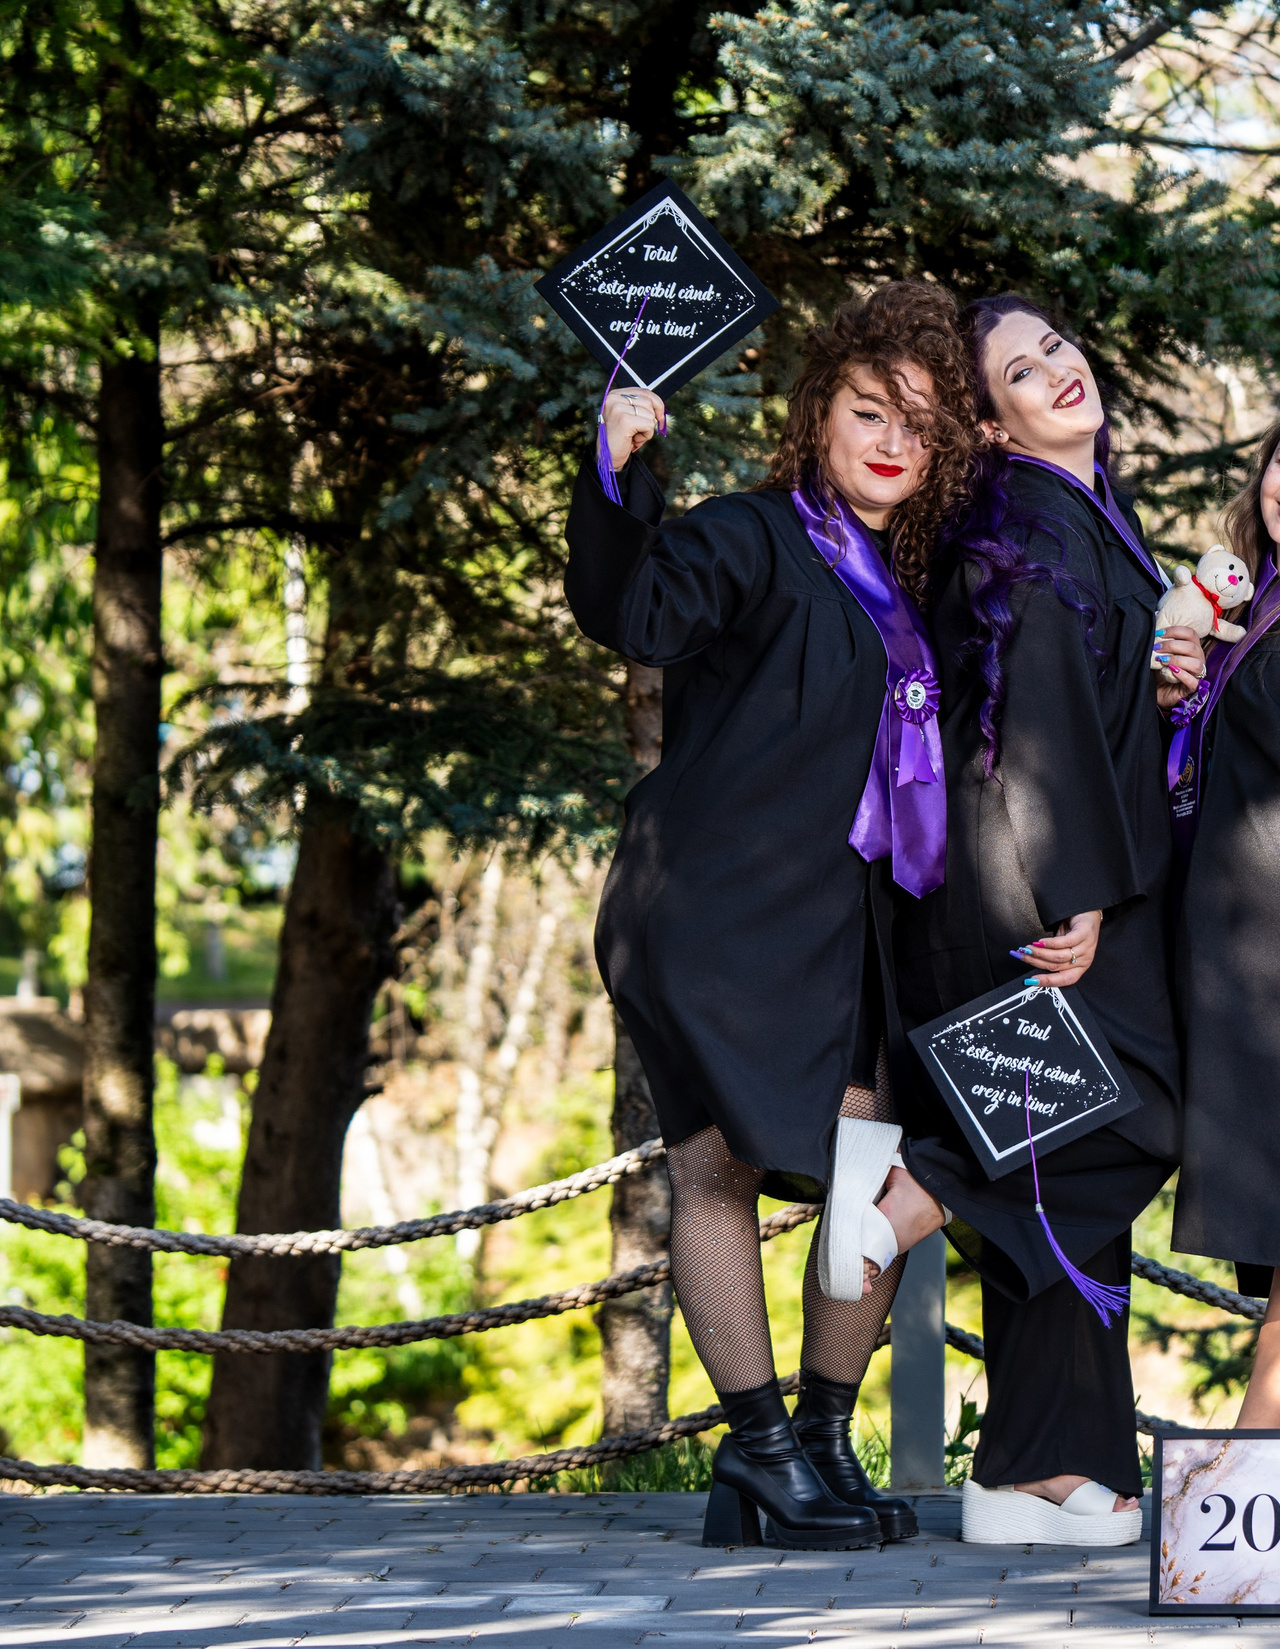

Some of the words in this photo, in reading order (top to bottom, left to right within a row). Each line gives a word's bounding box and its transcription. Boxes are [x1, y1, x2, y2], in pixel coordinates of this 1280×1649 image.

[643, 245, 678, 262] Totul
[598, 280, 626, 295] este
[678, 284, 714, 301] când
[646, 320, 661, 335] în
[664, 320, 697, 339] tine!
[1016, 1018, 1052, 1041] Totul
[966, 1045, 996, 1061] este
[992, 1053, 1044, 1076] posibil
[1044, 1065, 1080, 1086] când
[971, 1084, 1006, 1115] crezi
[1007, 1090, 1021, 1107] în
